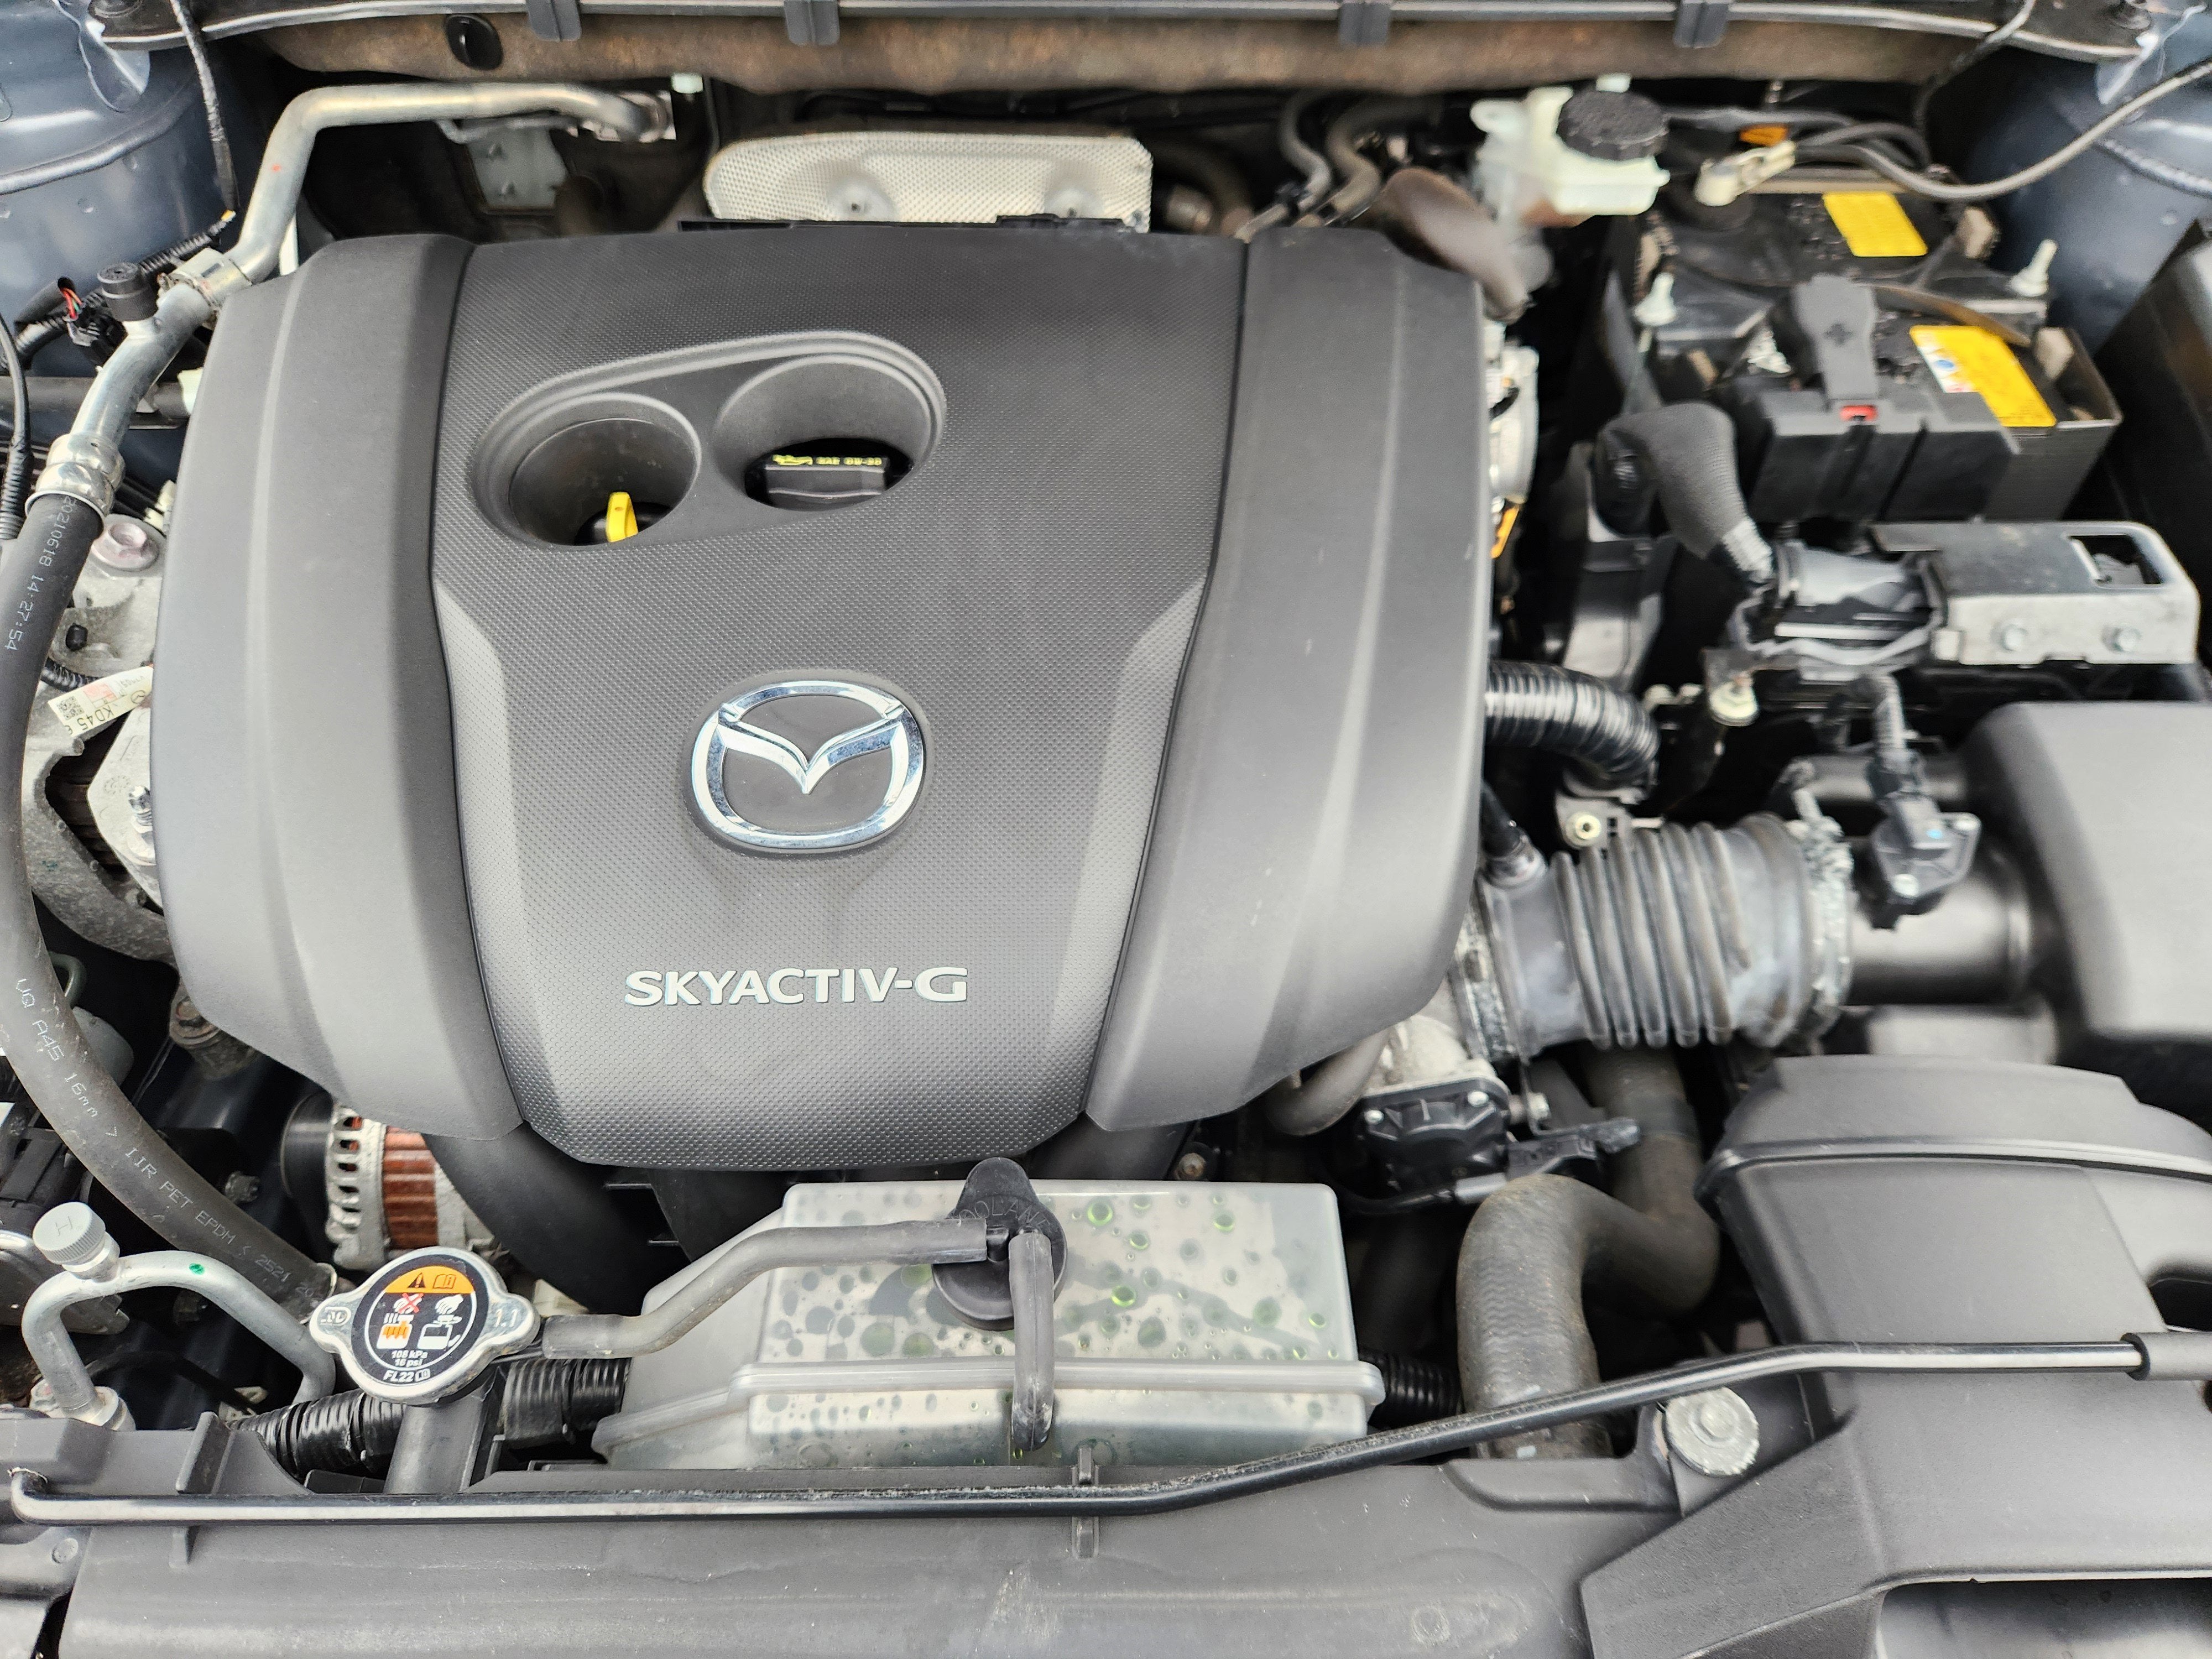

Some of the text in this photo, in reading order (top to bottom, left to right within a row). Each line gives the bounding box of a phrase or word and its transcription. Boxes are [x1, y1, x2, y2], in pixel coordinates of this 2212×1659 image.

[4, 495, 77, 651] 20210618 14:27:54
[77, 705, 114, 731] KD45
[624, 966, 969, 1006] SKYACTIV-G
[32, 1020, 65, 1062] A45
[64, 1073, 98, 1118] 16mm
[124, 1147, 158, 1179] IIR
[159, 1180, 194, 1208] PET
[195, 1210, 237, 1245] EPDM
[55, 1215, 74, 1237] H
[494, 1308, 518, 1327] 1.1
[391, 1349, 429, 1359] 108 kPa
[394, 1358, 424, 1368] 16 psi
[382, 1369, 415, 1383] FL22
